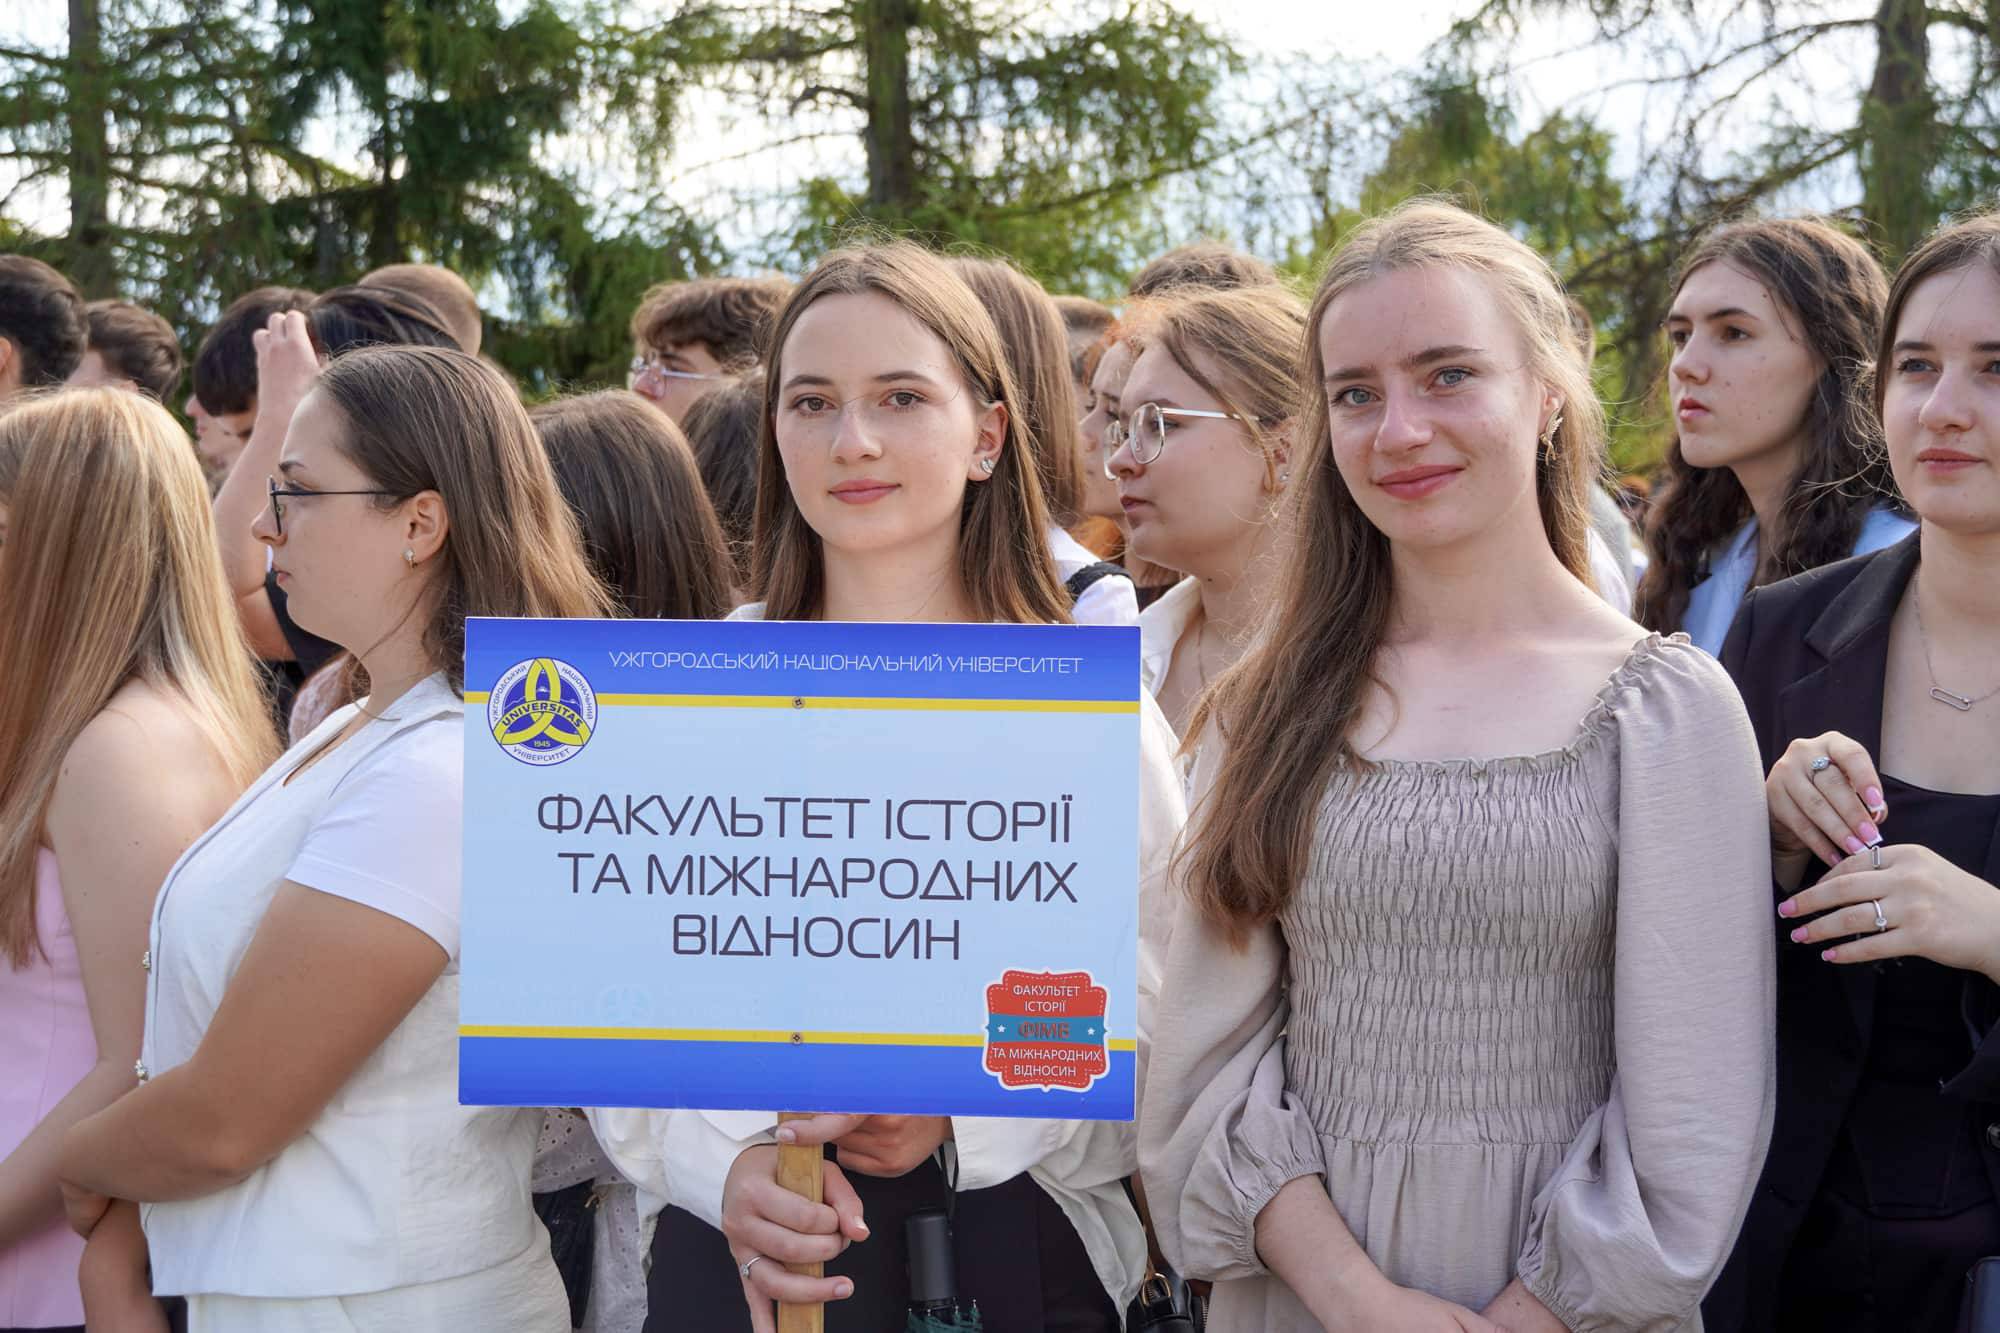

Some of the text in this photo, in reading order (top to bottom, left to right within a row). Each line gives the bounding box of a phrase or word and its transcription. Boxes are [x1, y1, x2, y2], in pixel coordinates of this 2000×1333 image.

[608, 651, 1083, 674] УЖГОРОДСЬКИЙ НАЦІОНАЛЬНИЙ УНІВЕРСИТЕТ
[502, 702, 583, 727] UNIVERSITAS
[513, 746, 570, 762] УНІВЕРСИТЕТ
[537, 793, 1073, 843] ФАКУЛЬТЕТ ІСТОРІЇ
[557, 852, 1078, 903] ТА МІЖНАРОДНИХ
[673, 914, 960, 961] ВІДНОСИН
[1012, 984, 1080, 997] ФАКУЛЬТЕТ
[1024, 999, 1066, 1012] ІСТОРІЇ
[992, 1047, 1101, 1062] ТА МІЖНАРОДНИХ
[1013, 1064, 1077, 1077] ВІДНОСИН
